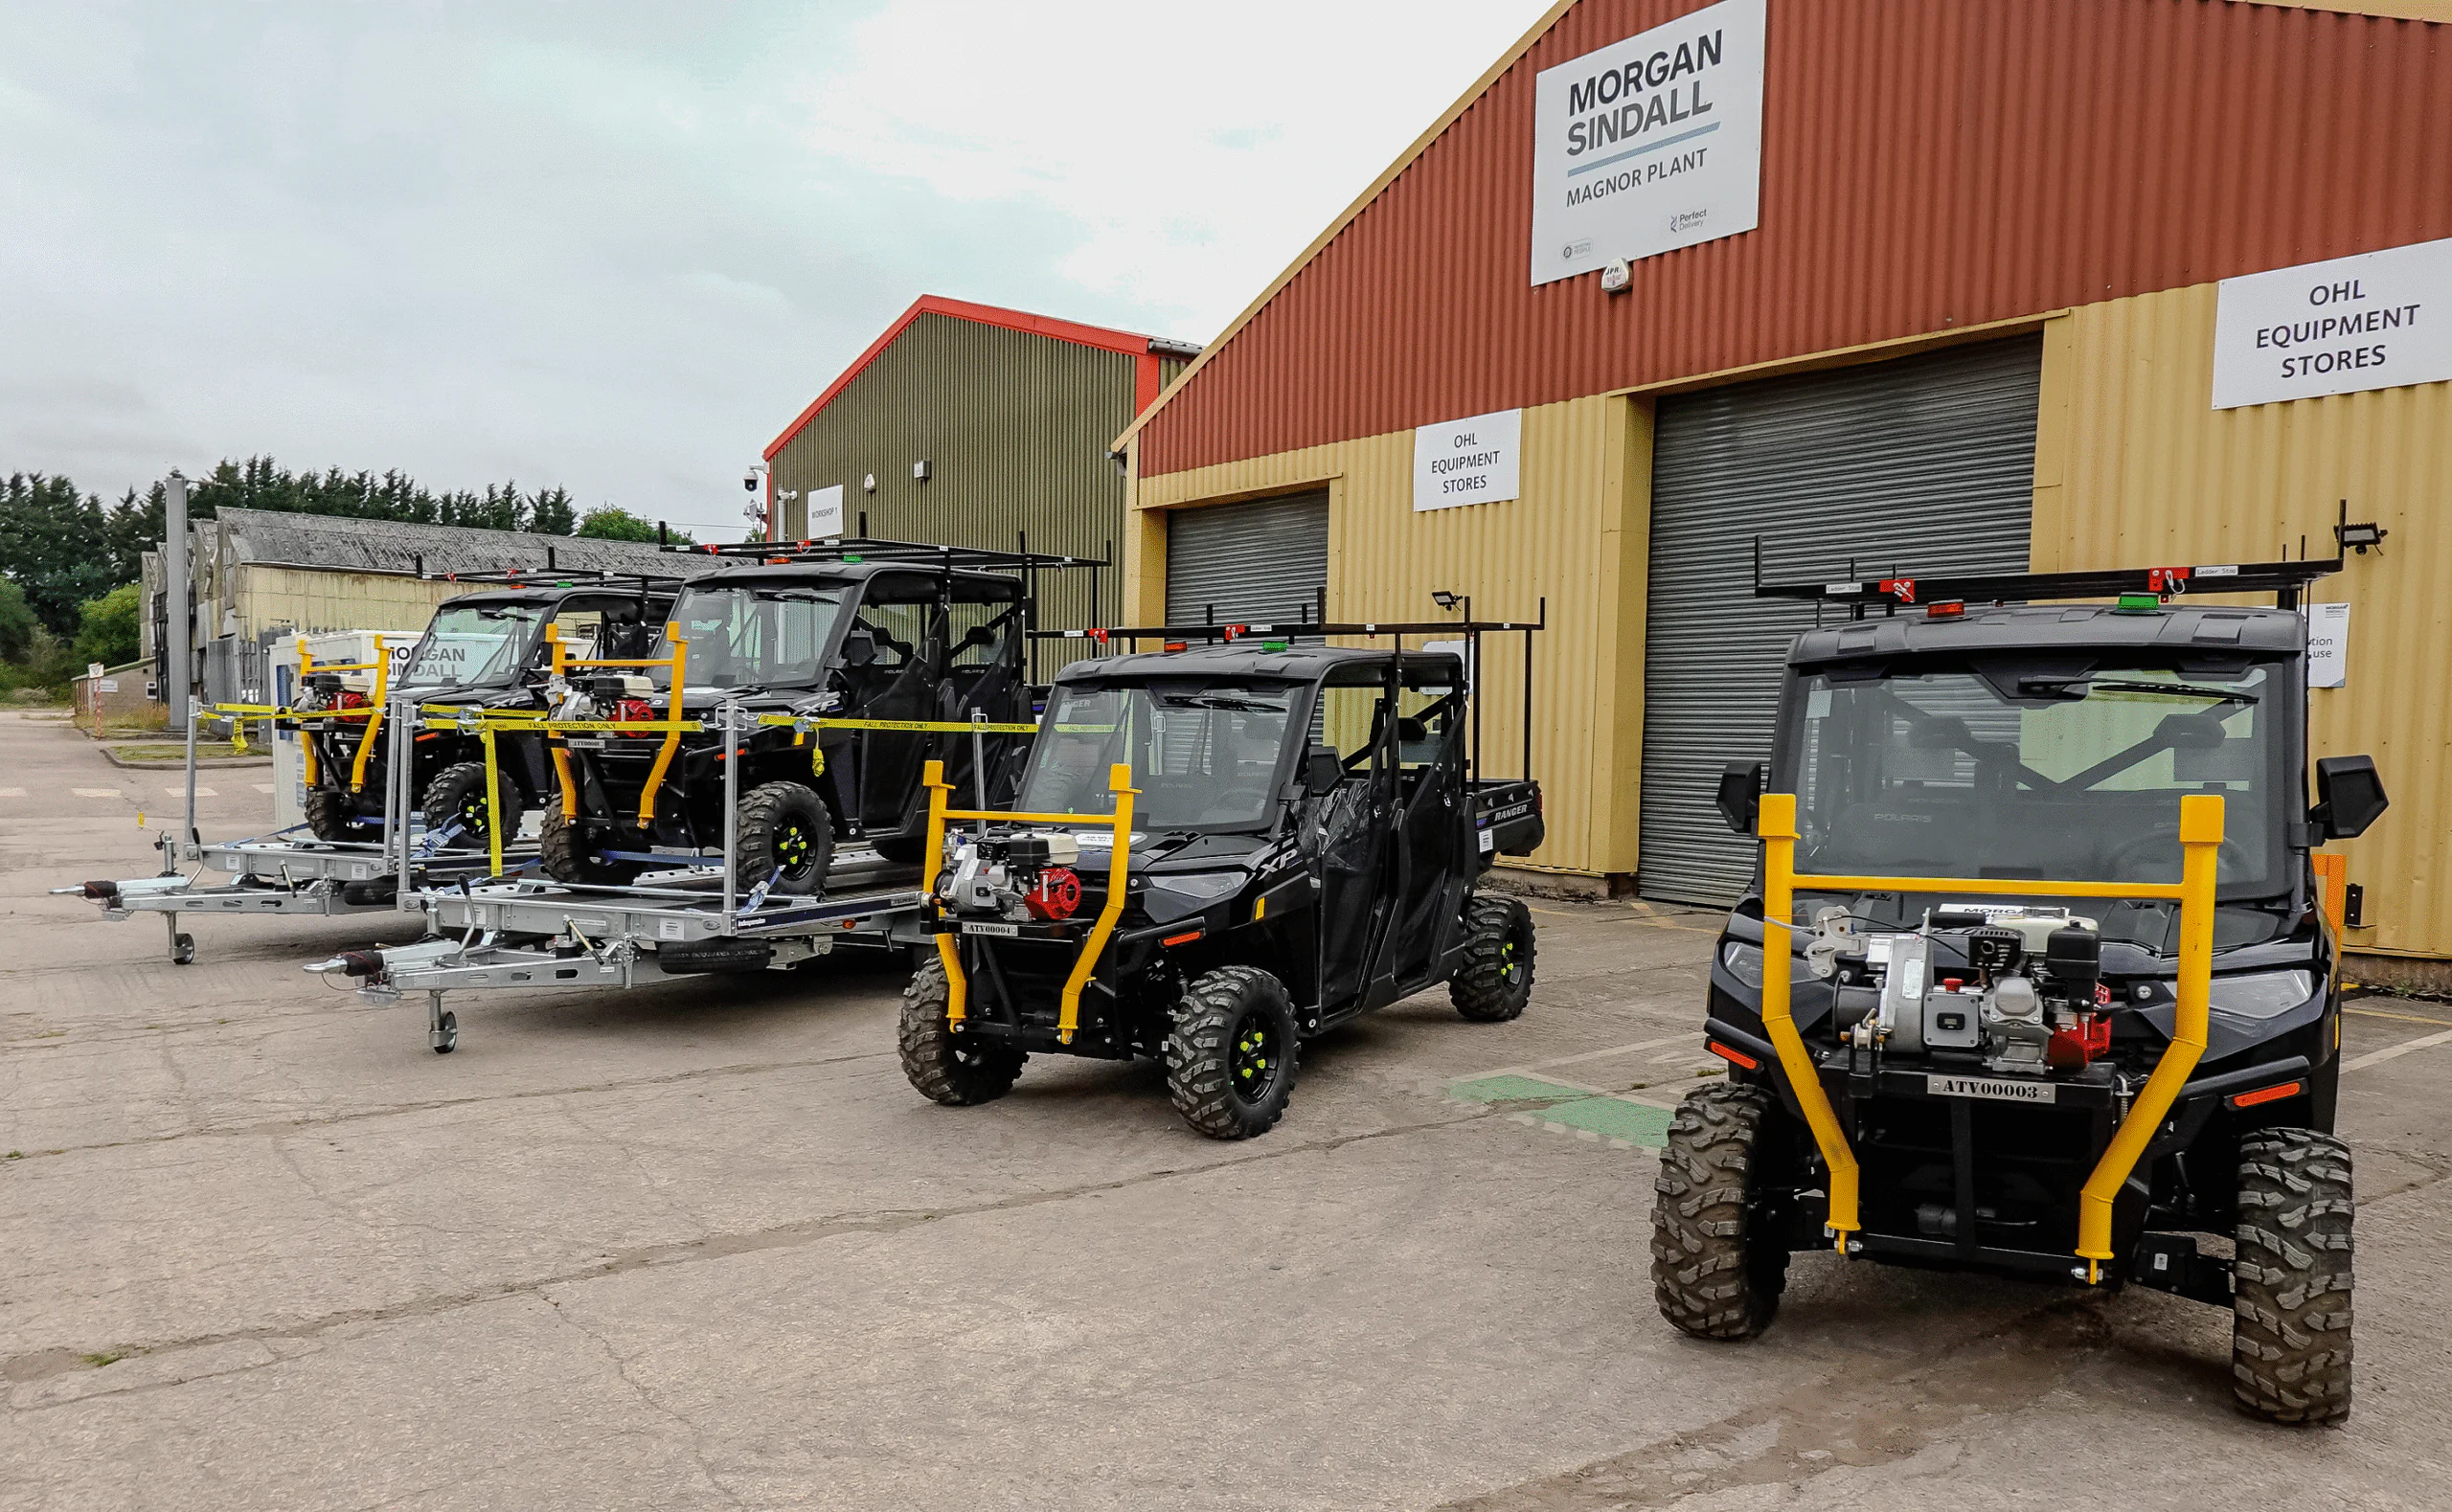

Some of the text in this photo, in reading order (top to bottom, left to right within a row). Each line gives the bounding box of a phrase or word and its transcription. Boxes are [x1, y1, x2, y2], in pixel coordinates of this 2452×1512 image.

[1569, 29, 1722, 117] MORGAN
[1567, 80, 1714, 156] SINDALL
[1567, 147, 1708, 208] MAGNOR PLANT
[1679, 209, 1707, 222] Perfect
[2309, 280, 2366, 305] OHL
[2256, 304, 2420, 349] EQUIPMENT
[2281, 345, 2386, 378] STORES
[1454, 433, 1477, 448] OHL
[1432, 450, 1500, 474] EQUIPMENT
[1442, 475, 1487, 494] STORES
[800, 700, 839, 716] XP
[1494, 804, 1528, 822] RANGER
[1258, 848, 1298, 881] XP
[1942, 1079, 2038, 1098] ATV00003
